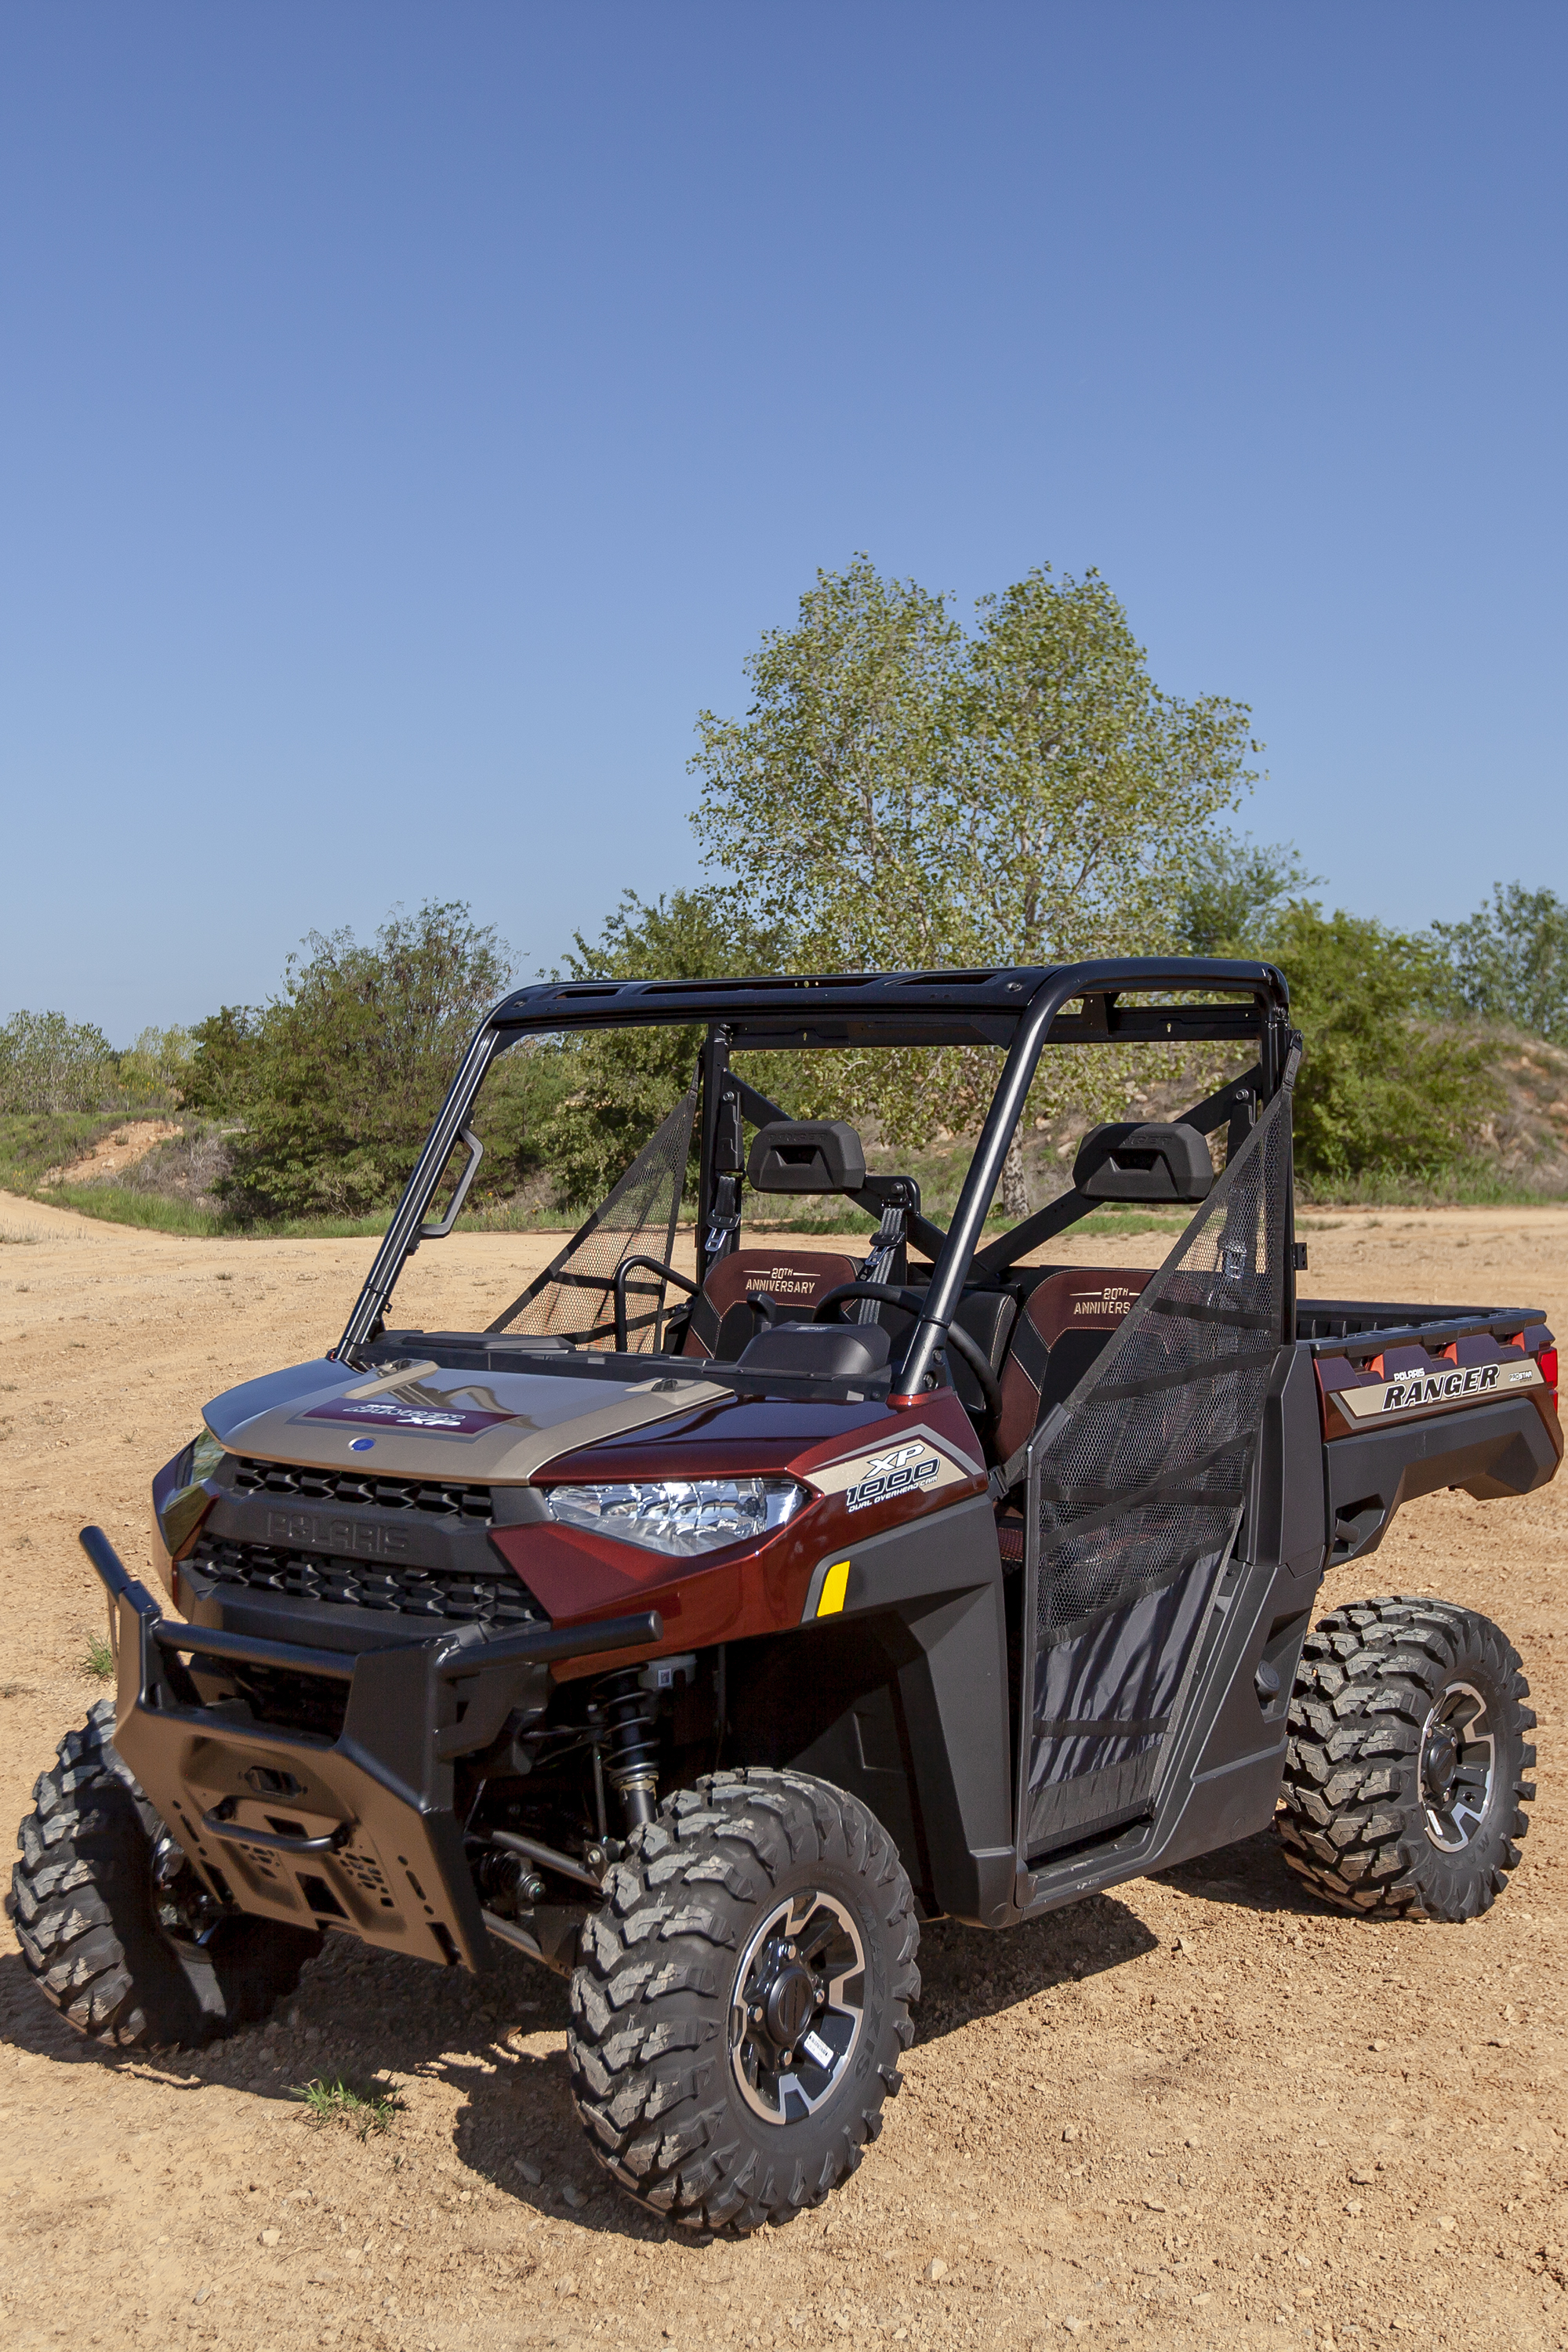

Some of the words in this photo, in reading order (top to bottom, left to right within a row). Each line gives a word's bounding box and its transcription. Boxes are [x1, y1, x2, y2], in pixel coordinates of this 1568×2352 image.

[771, 1268, 793, 1279] 20TH
[745, 1279, 815, 1294] ANNIVERSARY
[1102, 1287, 1129, 1300] 20TH
[1073, 1301, 1131, 1315] ANNIVERS
[1393, 1367, 1425, 1382] POLARIS
[1381, 1363, 1500, 1412] RANGER
[396, 1417, 462, 1426] XP
[862, 1443, 925, 1480] XP
[846, 1456, 941, 1507] 1000
[848, 1498, 873, 1513] DUAL
[873, 1483, 920, 1504] OVERHEAD
[920, 1475, 938, 1487] CAM
[267, 1509, 409, 1556] POLARIS
